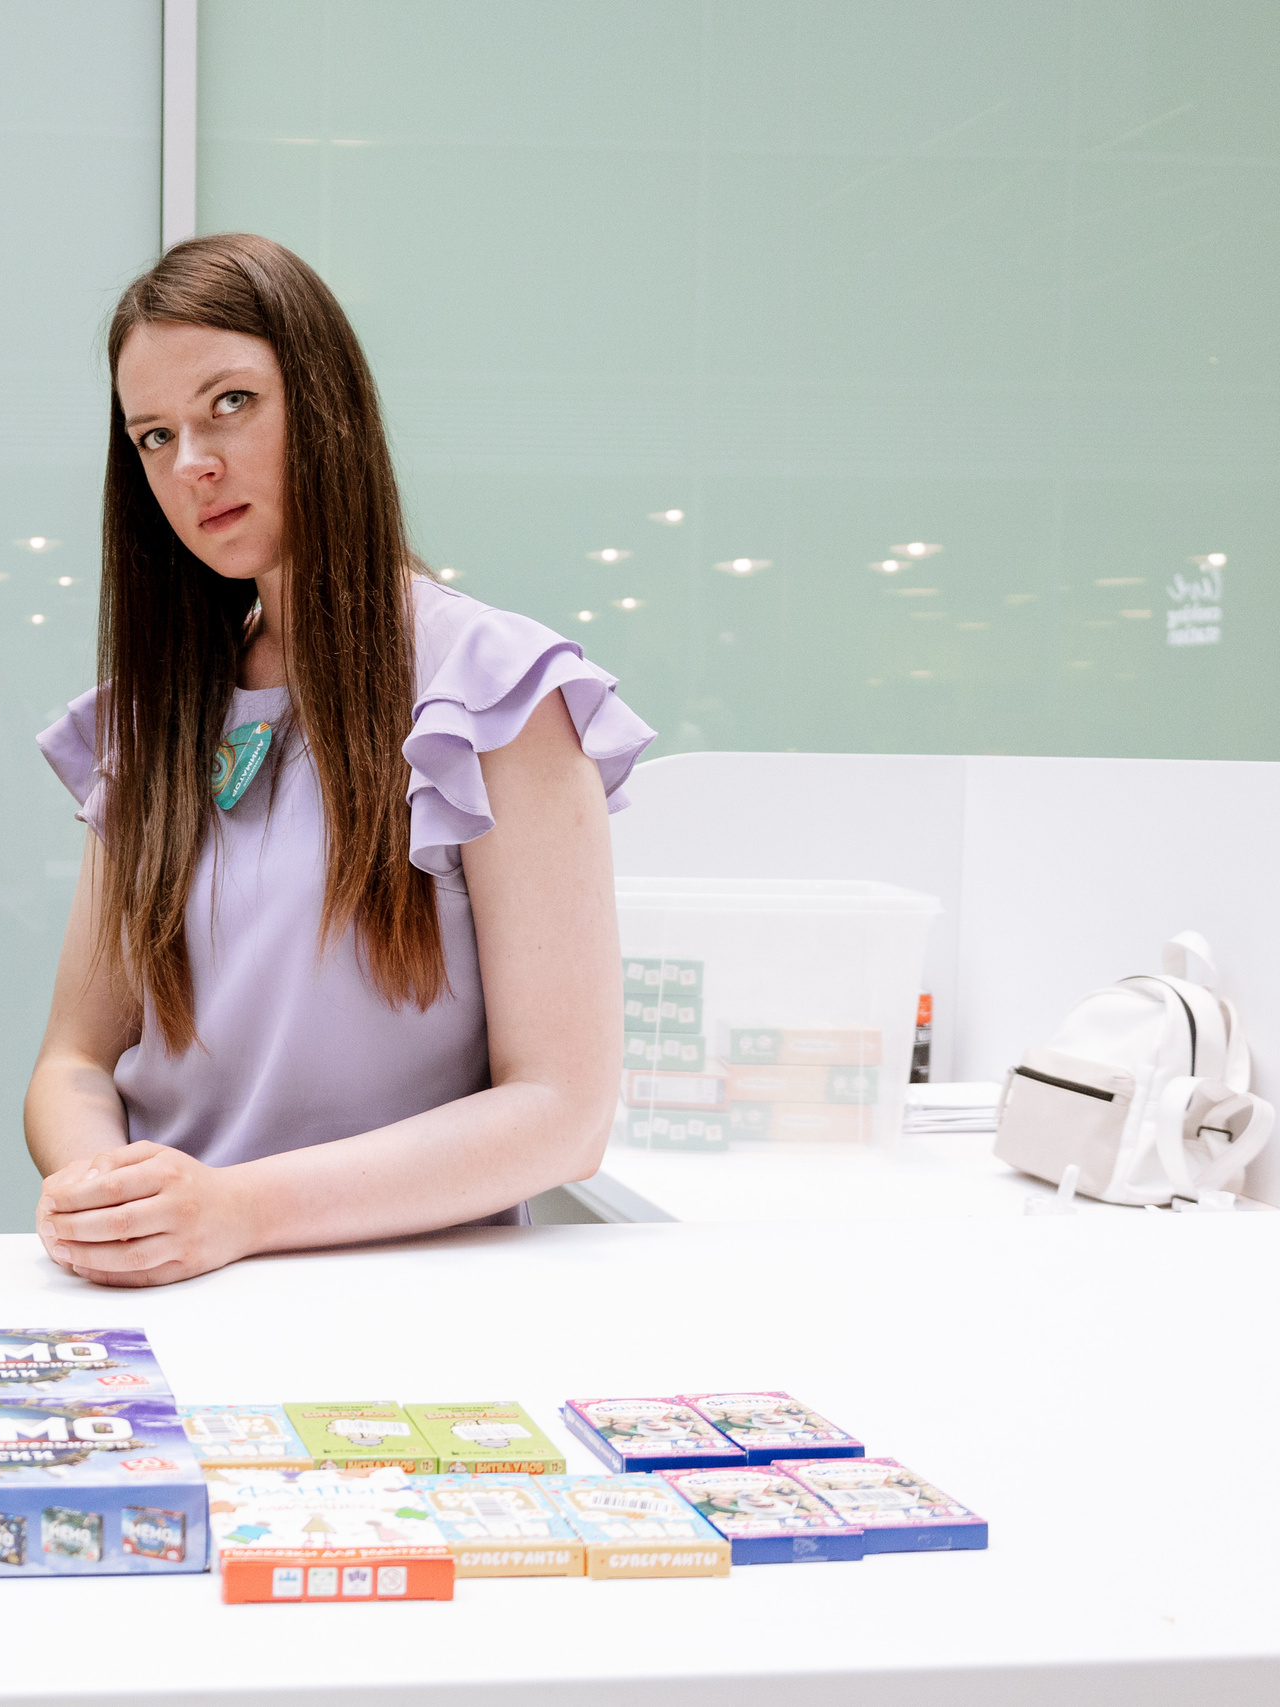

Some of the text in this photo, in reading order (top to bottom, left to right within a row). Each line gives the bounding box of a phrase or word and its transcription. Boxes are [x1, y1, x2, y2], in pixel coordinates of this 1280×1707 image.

[232, 739, 264, 797] АНИМАТОР
[102, 1375, 133, 1385] 50
[127, 1458, 161, 1469] 50
[461, 1551, 570, 1566] СУПЕРФАНТЫ
[608, 1553, 718, 1568] СУПЕРФАНТЫ
